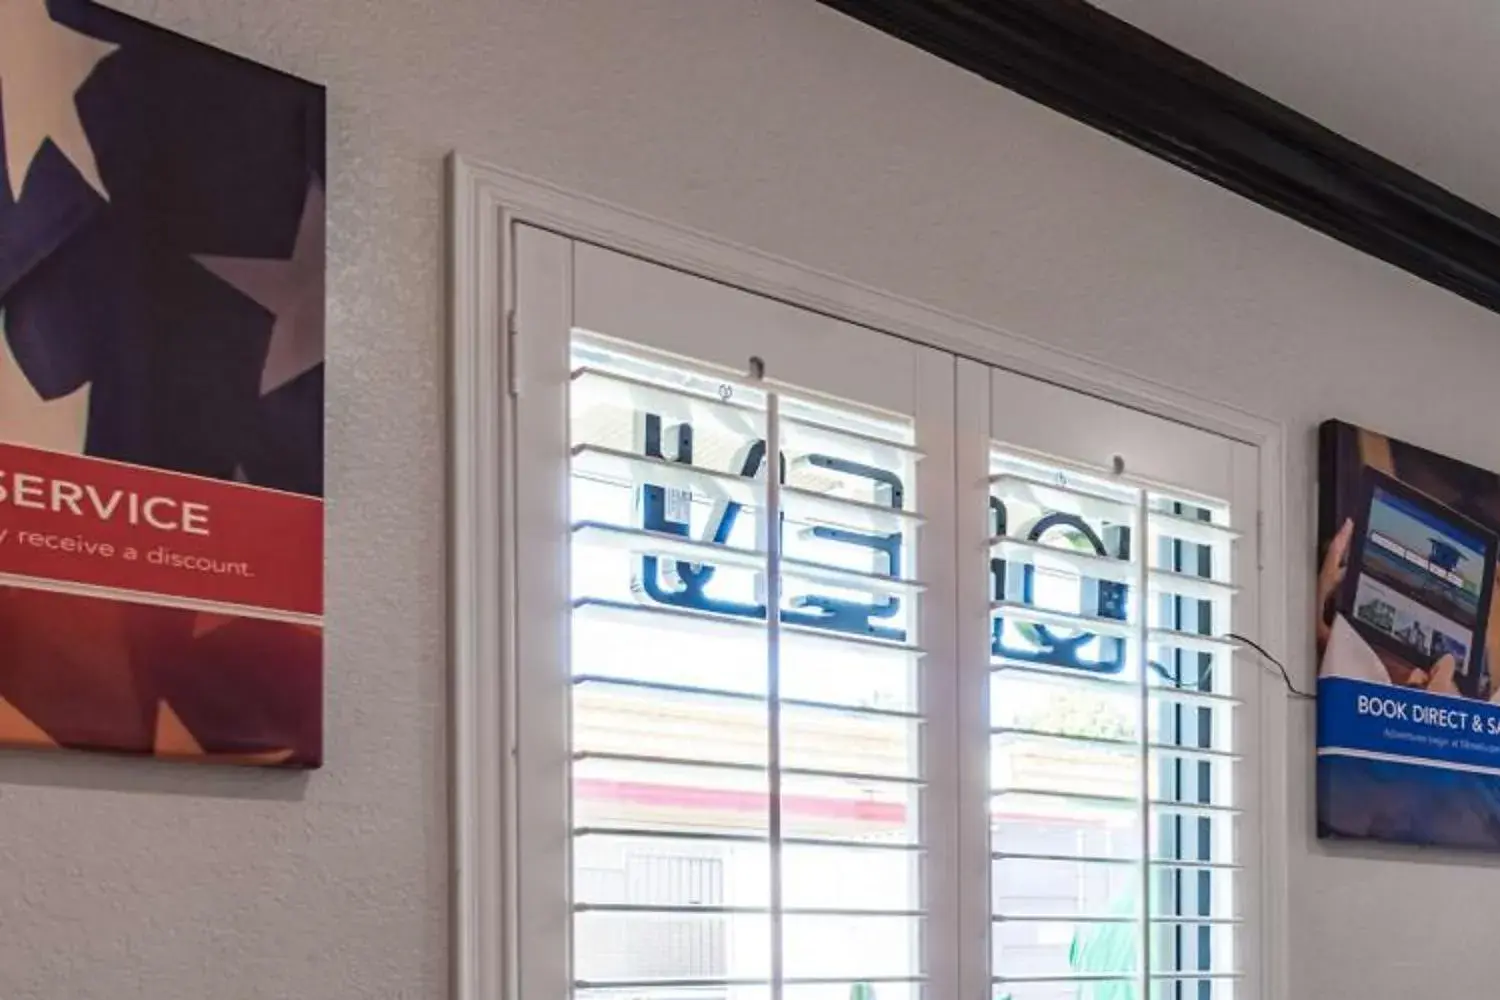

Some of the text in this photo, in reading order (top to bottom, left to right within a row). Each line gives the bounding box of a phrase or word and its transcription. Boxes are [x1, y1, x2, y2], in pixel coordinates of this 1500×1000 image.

[0, 470, 210, 536] ERVICE
[18, 529, 114, 557] receive
[123, 546, 137, 561] a
[147, 546, 255, 578] discount.
[1357, 695, 1408, 721] BOOK
[1412, 705, 1468, 730] DIRECT
[1471, 714, 1483, 733] &
